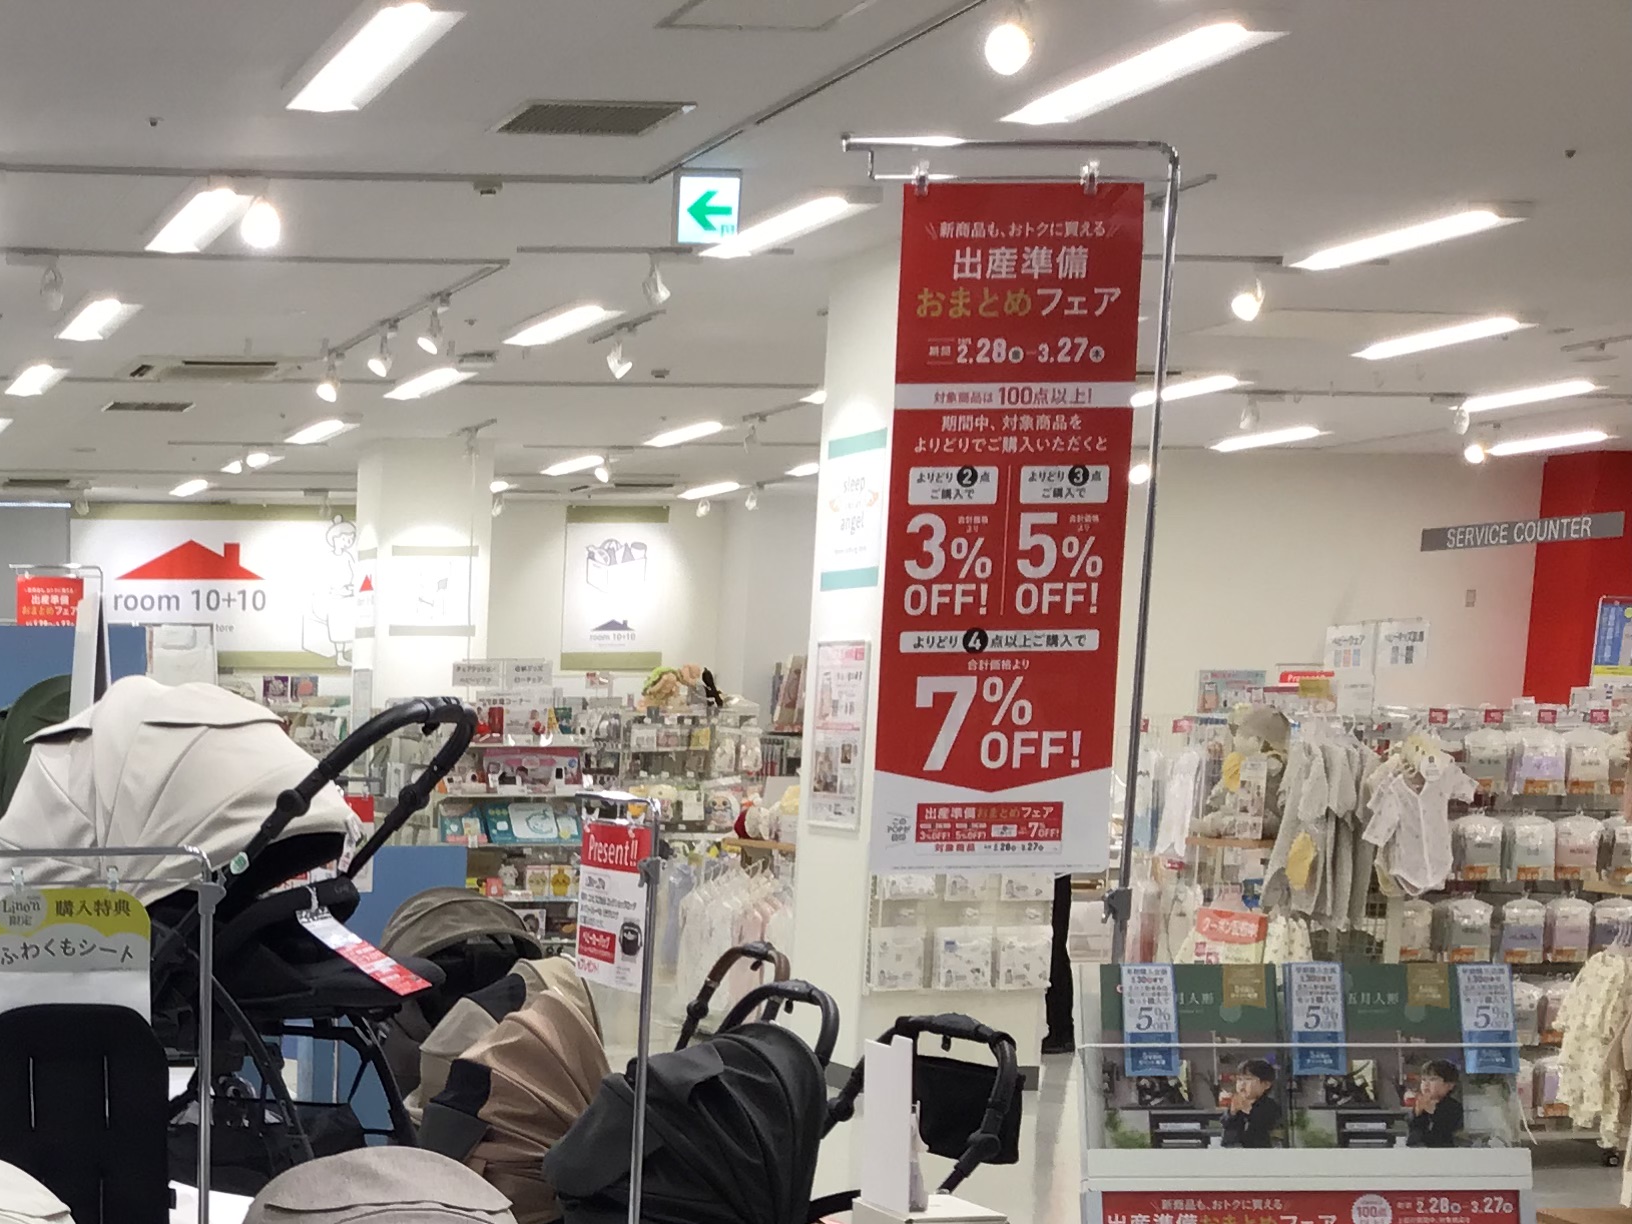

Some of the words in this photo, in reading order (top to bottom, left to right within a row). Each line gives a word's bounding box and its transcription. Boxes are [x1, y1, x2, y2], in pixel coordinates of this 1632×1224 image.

[939, 221, 1106, 239] 新商品も、おトクに買える
[953, 245, 1089, 280] 出産準備
[916, 286, 1121, 318] おまとめフェア
[941, 413, 1083, 432] 期間中、対象商品を
[914, 436, 1107, 455] よりどりでご購入いただくと
[930, 488, 975, 500] ご購入で
[1041, 487, 1086, 499] ご購入で
[1446, 523, 1508, 548] SERVICE
[1513, 516, 1592, 543] COUNTER
[113, 592, 180, 611] room
[191, 589, 266, 611] 10+10
[903, 583, 988, 616] OFF!
[1015, 582, 1099, 615] OFF!
[967, 659, 1030, 671] 合計価格より
[980, 730, 1082, 769] OFF!
[55, 899, 131, 917] 購入特典
[1, 938, 134, 965] ふわくもシート
[1347, 992, 1399, 1006] 五月人形
